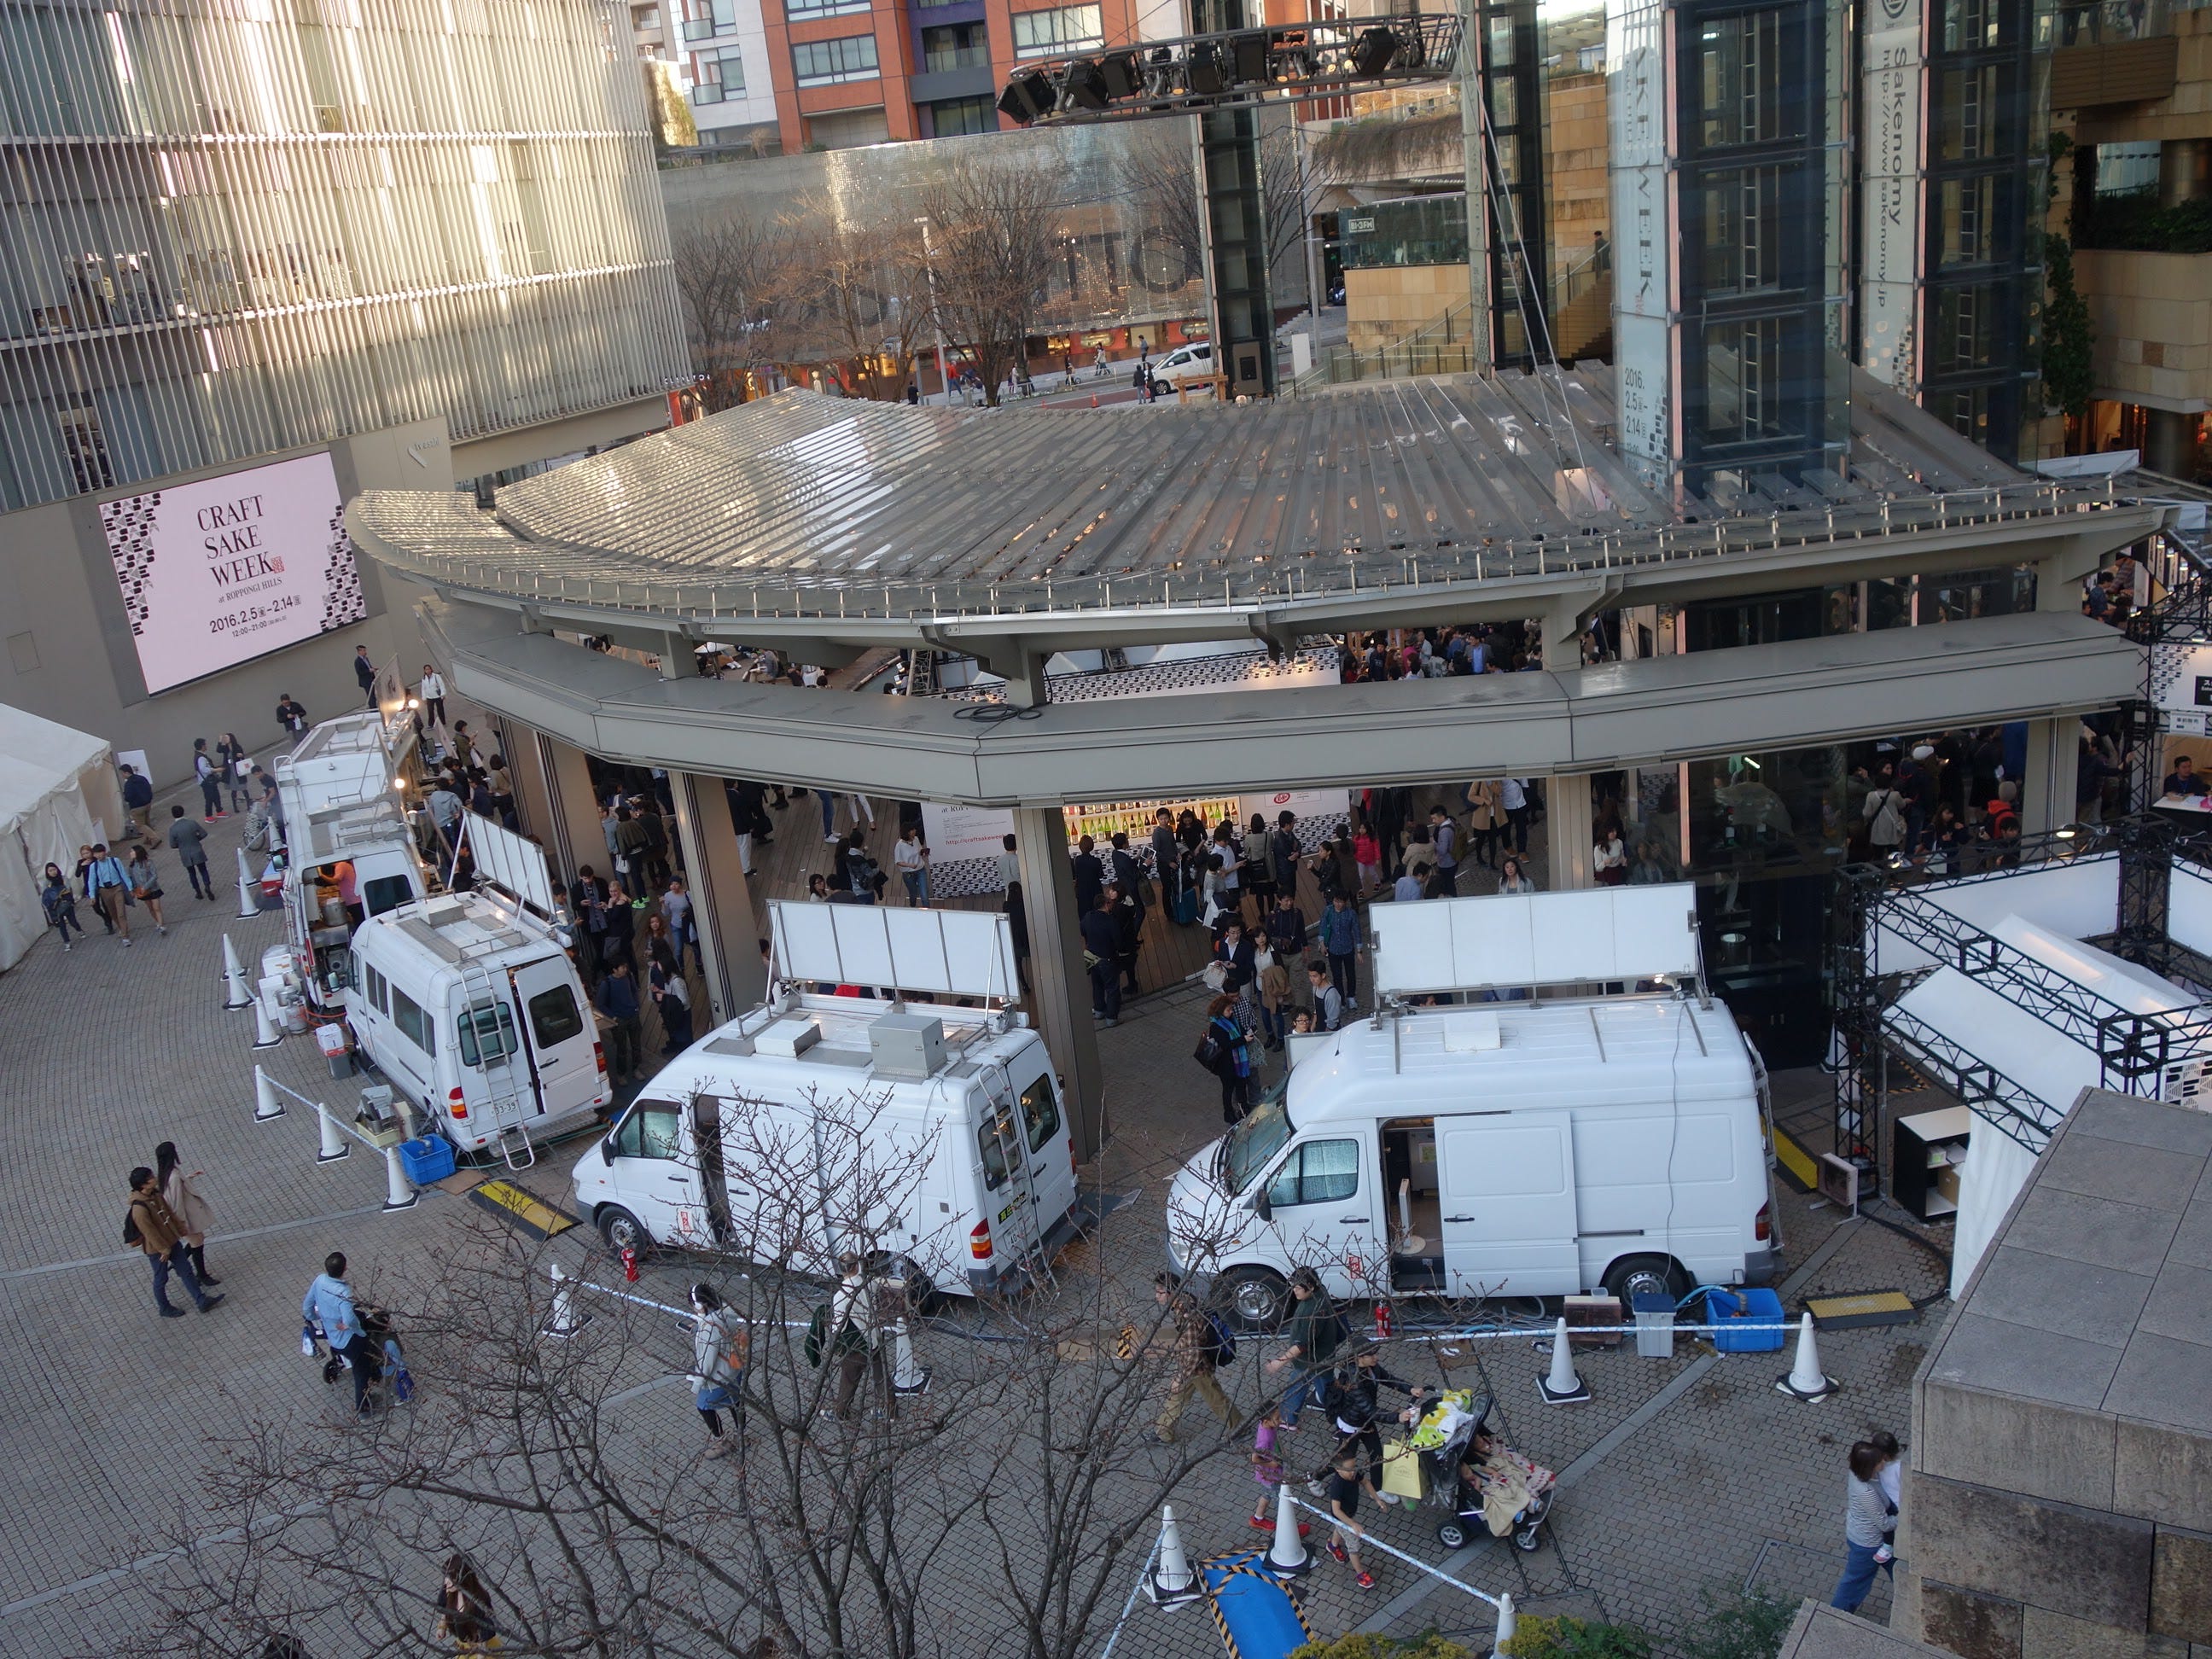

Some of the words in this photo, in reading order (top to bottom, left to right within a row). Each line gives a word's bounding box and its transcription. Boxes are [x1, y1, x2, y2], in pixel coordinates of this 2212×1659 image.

[1889, 47, 1907, 225] Sakenomy
[1638, 159, 1654, 298] WEEK
[197, 495, 264, 531] CRAFT
[205, 525, 262, 560] SAKE
[209, 551, 274, 587] WEEK
[225, 583, 261, 602] ROPPONGI
[262, 577, 282, 591] HILLS
